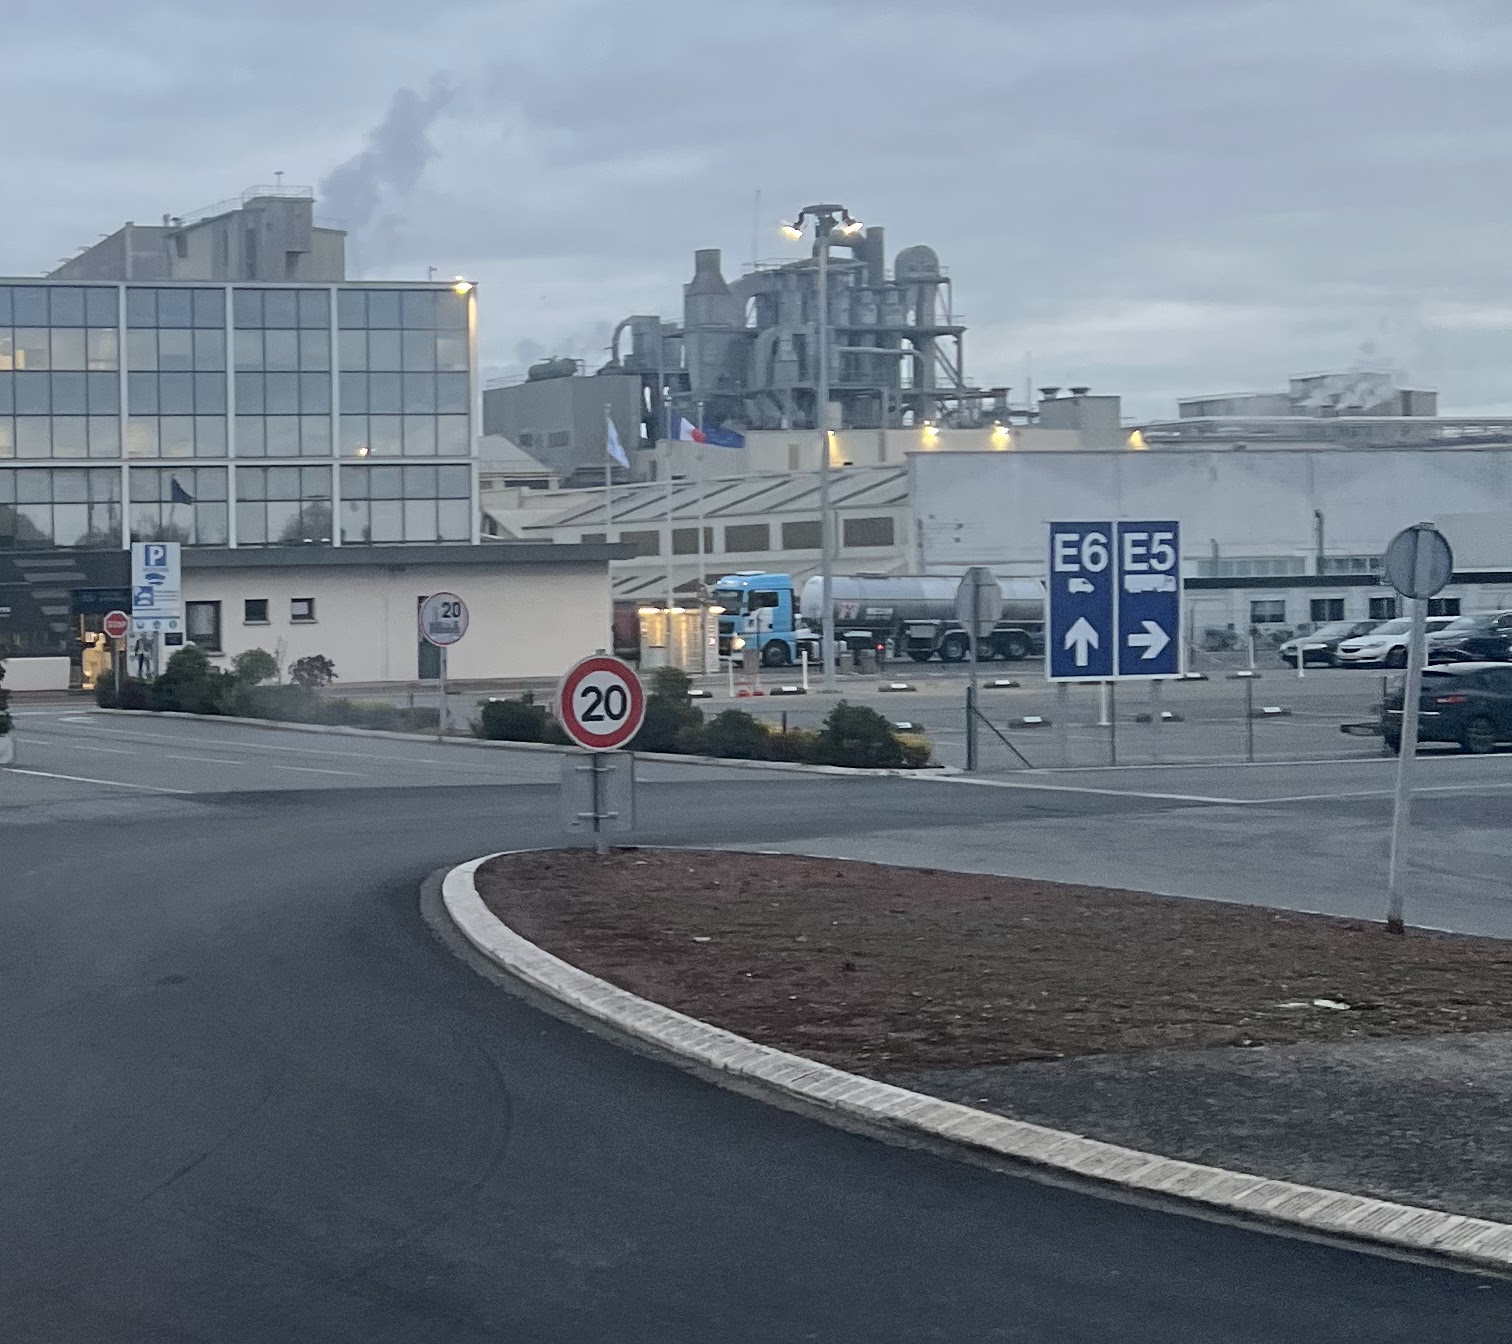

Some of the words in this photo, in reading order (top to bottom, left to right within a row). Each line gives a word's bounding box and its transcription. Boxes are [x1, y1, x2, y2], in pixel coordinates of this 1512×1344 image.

[149, 546, 164, 566] P
[1054, 532, 1108, 572] E6
[1123, 532, 1176, 571] E5
[441, 601, 461, 618] 20
[581, 685, 627, 722] 20
